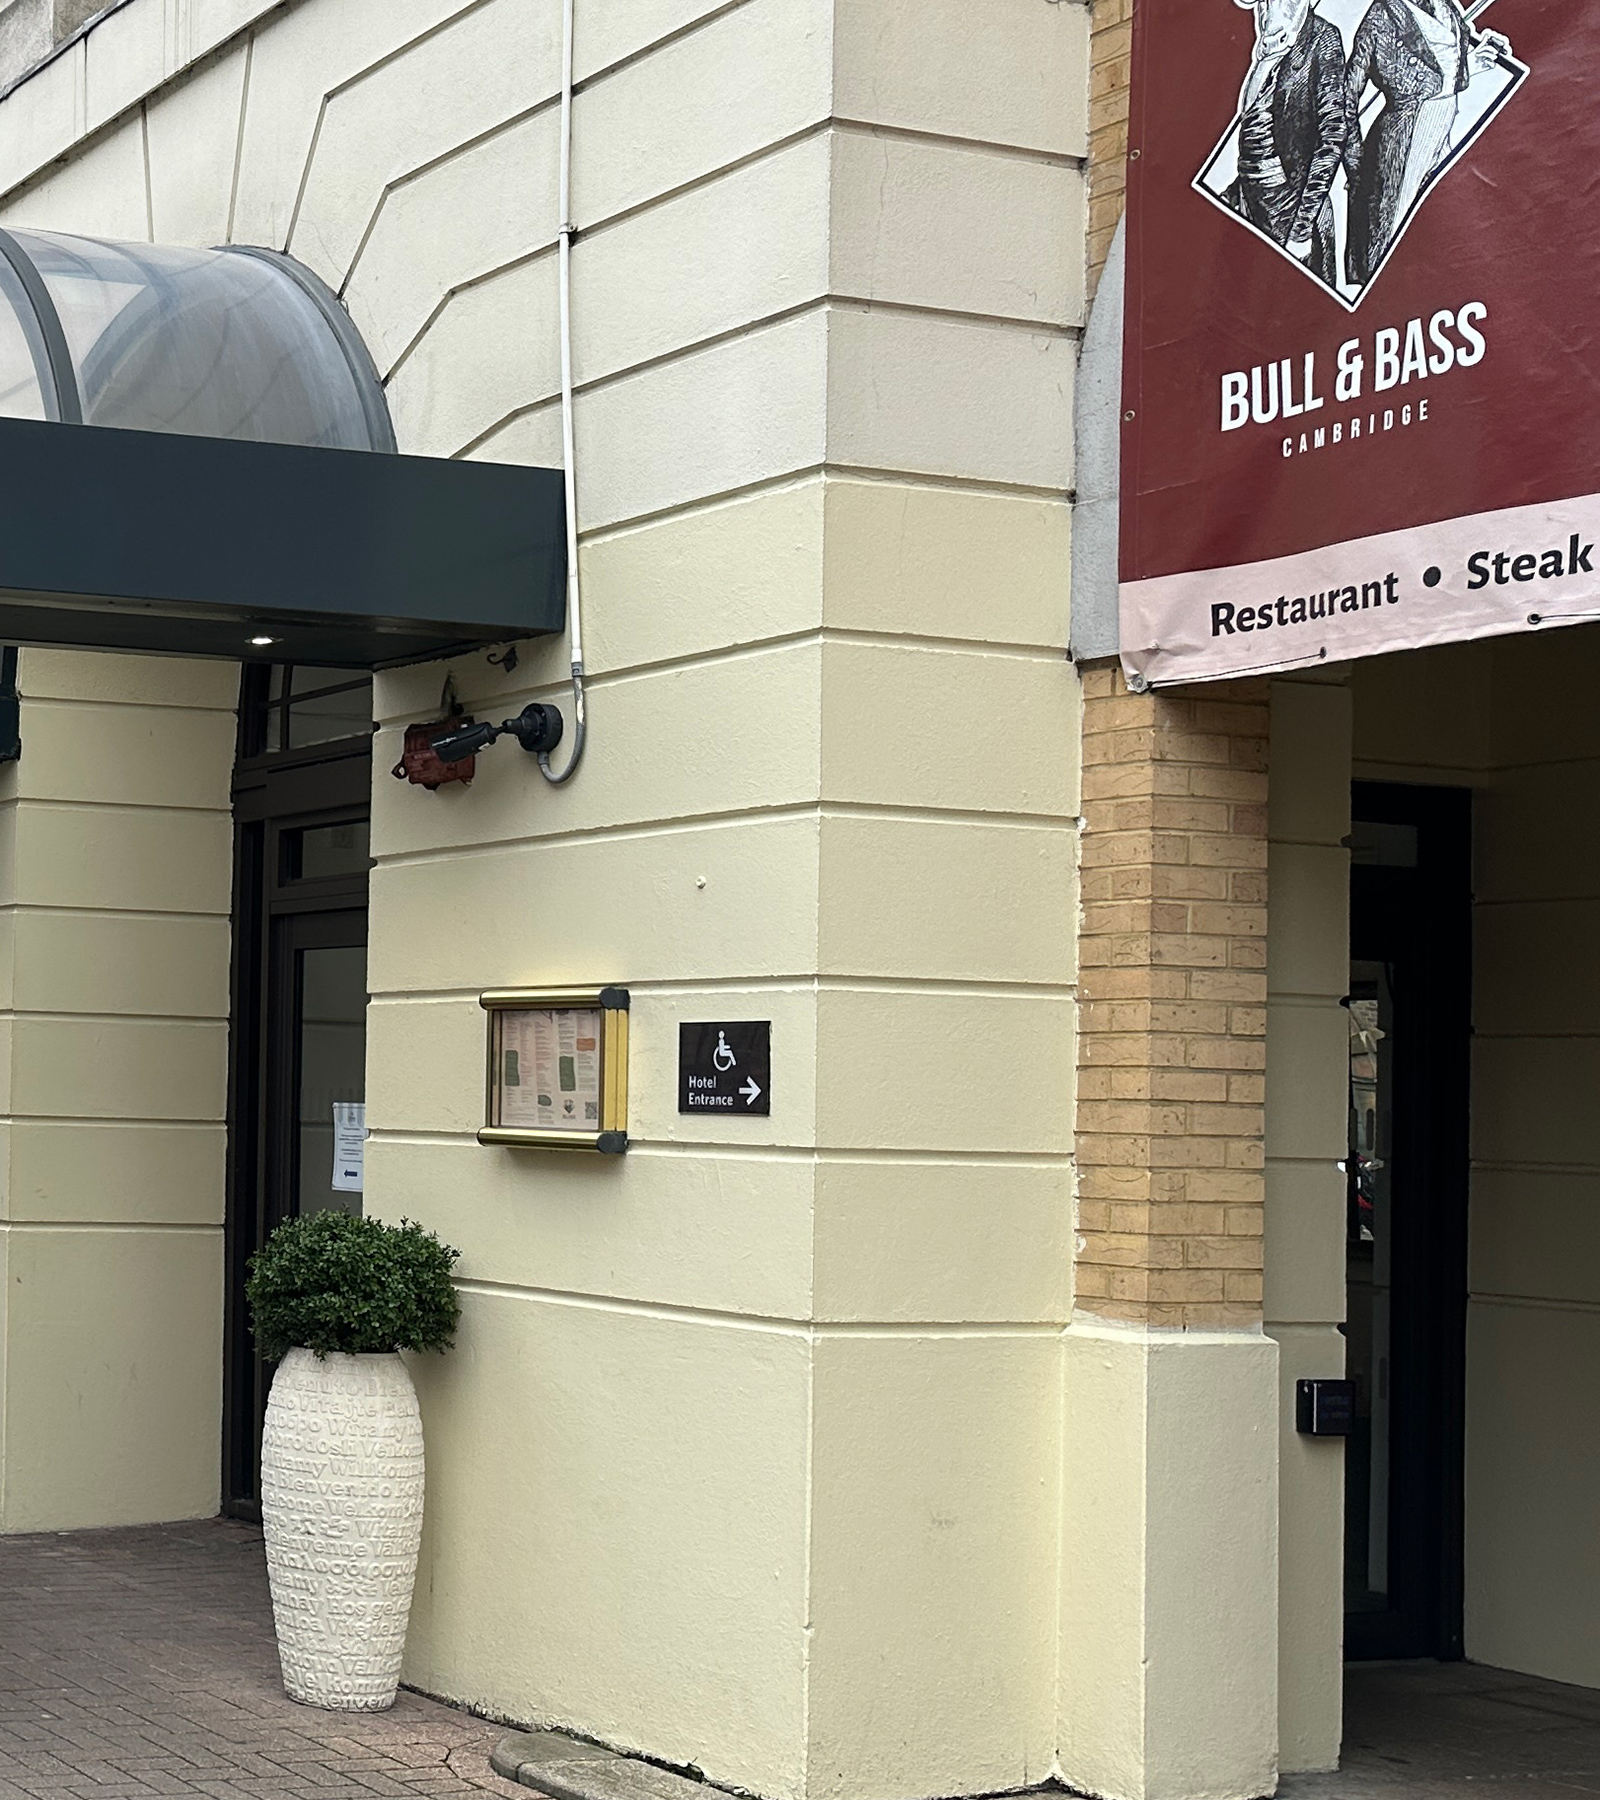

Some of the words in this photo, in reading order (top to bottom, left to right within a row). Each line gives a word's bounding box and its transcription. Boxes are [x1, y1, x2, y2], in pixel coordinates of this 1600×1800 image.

[1220, 351, 1324, 432] BULL
[1335, 337, 1364, 402] &
[1374, 301, 1488, 392] BASS
[1281, 399, 1429, 458] CAMBRIDGE
[1210, 572, 1400, 637] Restaurant
[1466, 533, 1595, 590] Steak
[688, 1075, 717, 1088] Hotel
[688, 1092, 734, 1106] Entrance
